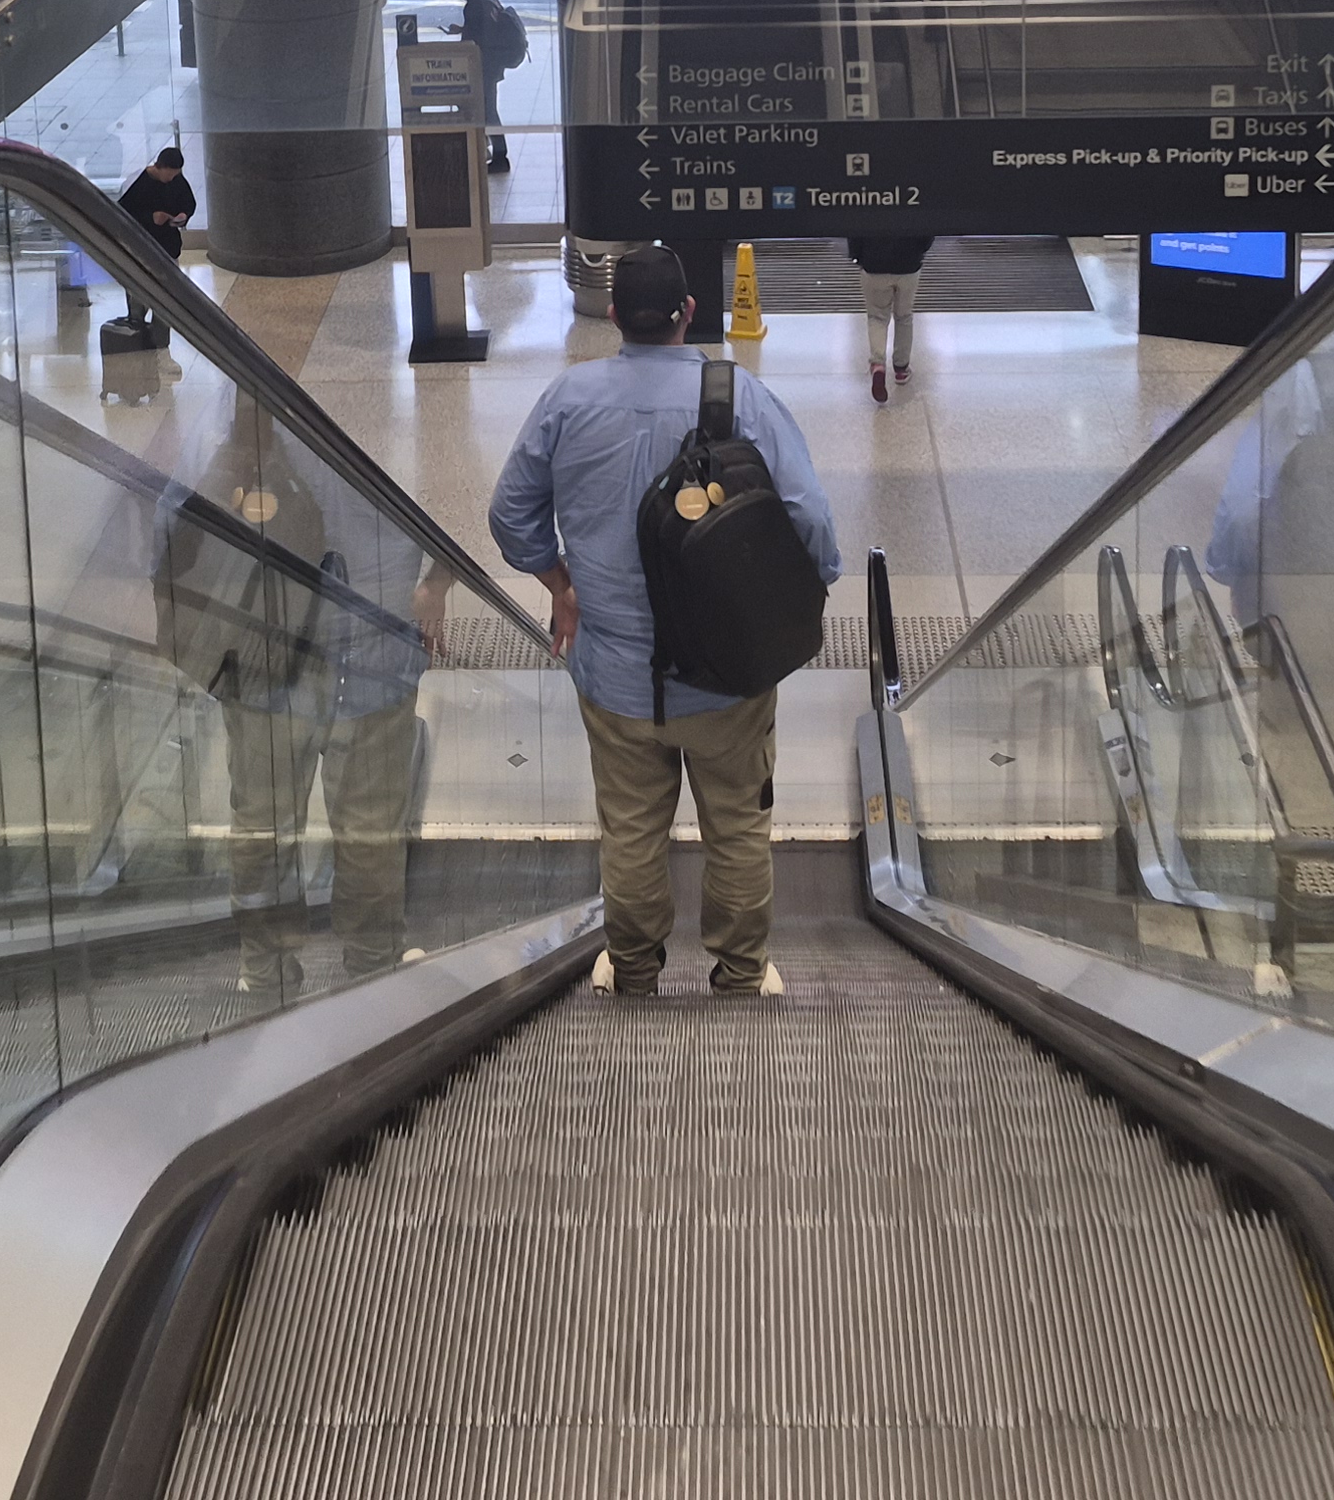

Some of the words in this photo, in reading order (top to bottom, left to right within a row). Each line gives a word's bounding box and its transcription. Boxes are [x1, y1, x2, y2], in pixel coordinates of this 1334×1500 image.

[1267, 54, 1308, 73] Exit
[412, 72, 467, 83] INFORMATION
[669, 64, 766, 87] Baggage
[773, 62, 835, 81] Claim
[669, 93, 739, 113] Rental
[747, 95, 793, 113] Cars
[1254, 85, 1308, 105] Taxis
[670, 125, 727, 145] Valet
[734, 124, 818, 147] Parking
[1245, 117, 1308, 136] Buses
[671, 155, 736, 175] Trains
[992, 150, 1067, 168] Express
[1072, 149, 1141, 167] Pick-up
[1146, 148, 1161, 163] &
[1167, 147, 1233, 167] Priority
[1238, 147, 1309, 164] Pick-up
[1257, 175, 1306, 193] Uber
[773, 191, 794, 205] T2
[806, 186, 900, 207] Terminal
[907, 186, 920, 206] 2
